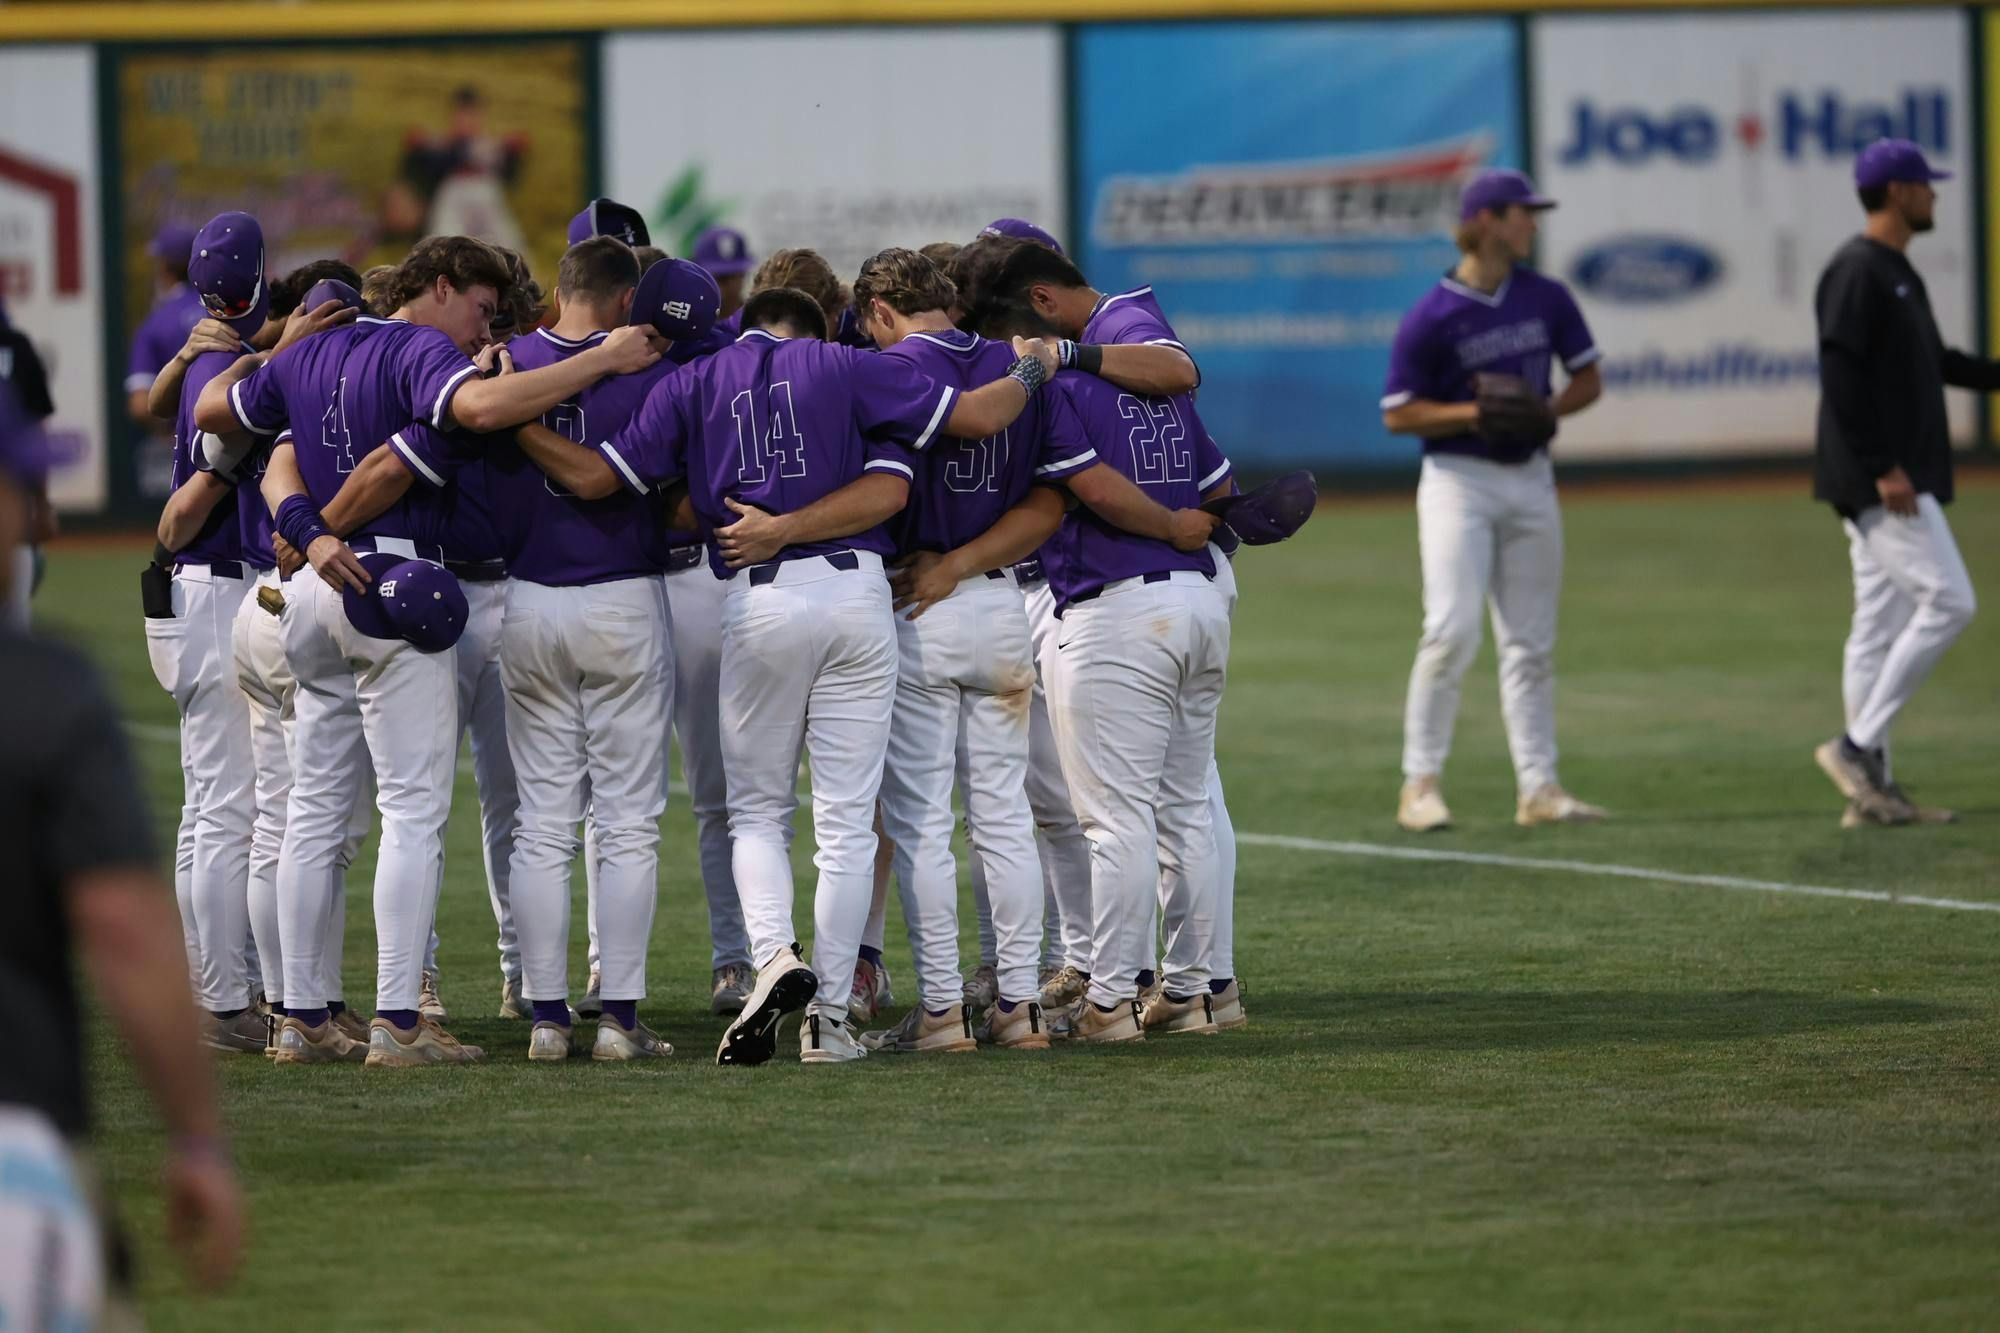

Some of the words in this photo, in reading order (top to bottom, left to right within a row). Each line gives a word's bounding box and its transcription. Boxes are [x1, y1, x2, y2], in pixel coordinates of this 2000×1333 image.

[1558, 99, 1719, 166] Joe
[1777, 86, 1951, 161] Hall
[731, 380, 807, 484] 14
[1116, 393, 1192, 485] 22
